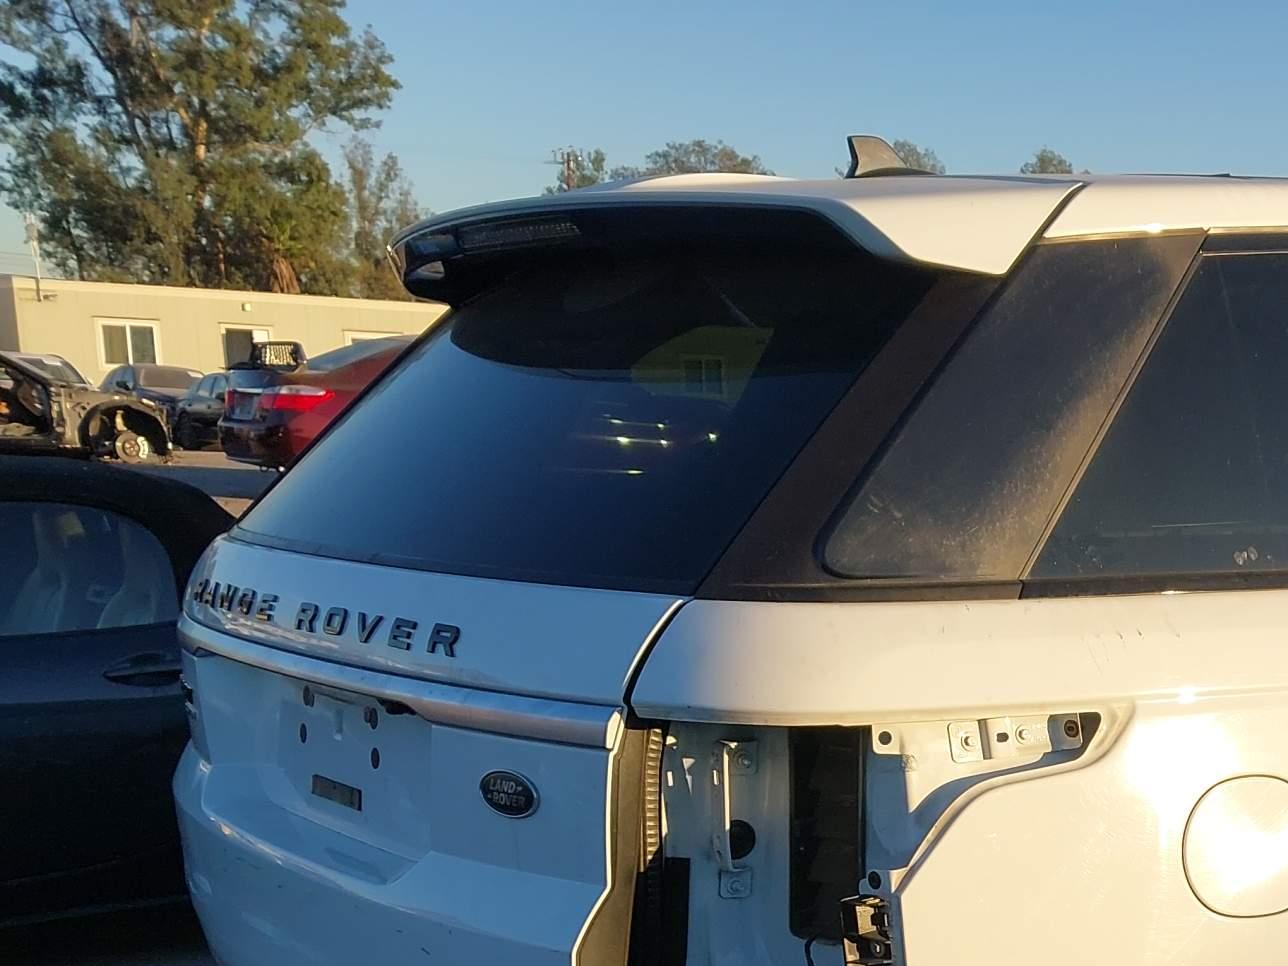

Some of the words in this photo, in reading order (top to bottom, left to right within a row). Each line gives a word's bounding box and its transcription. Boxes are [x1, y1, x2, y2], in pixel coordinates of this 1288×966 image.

[193, 578, 278, 621] RANGE
[294, 602, 461, 658] ROVER
[489, 778, 516, 793] LAND
[492, 791, 526, 808] ROVER
